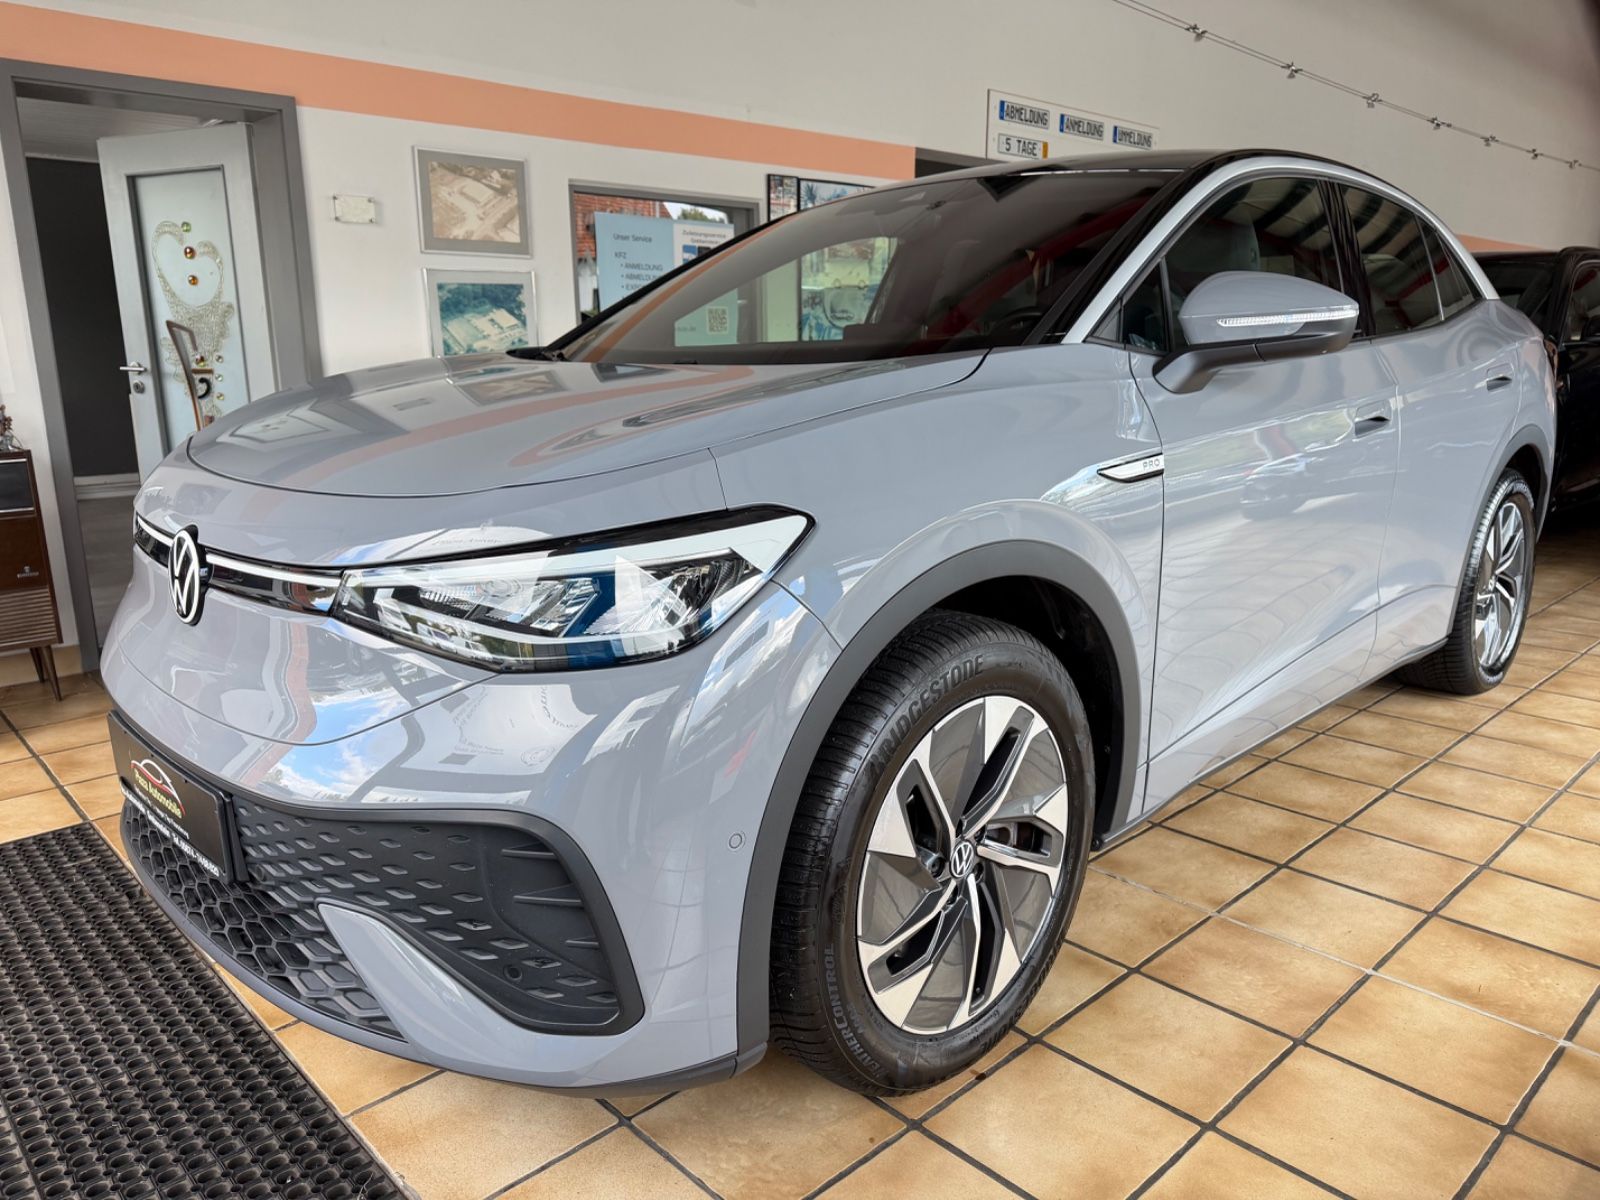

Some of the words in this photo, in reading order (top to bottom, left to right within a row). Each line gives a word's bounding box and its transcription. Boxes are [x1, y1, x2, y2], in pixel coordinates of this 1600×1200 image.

[1005, 104, 1048, 127] ABMELDUNG
[1065, 117, 1104, 138] ANMELDUNG
[1005, 138, 1011, 152] 5
[1017, 139, 1038, 157] TAGE
[1117, 129, 1152, 149] UMMELDUNG
[613, 232, 630, 241] Unser
[631, 234, 653, 243] Service
[624, 262, 663, 271] ANMELDUNG
[1142, 458, 1160, 471] PRO
[863, 653, 984, 781] BRIDGESTONE
